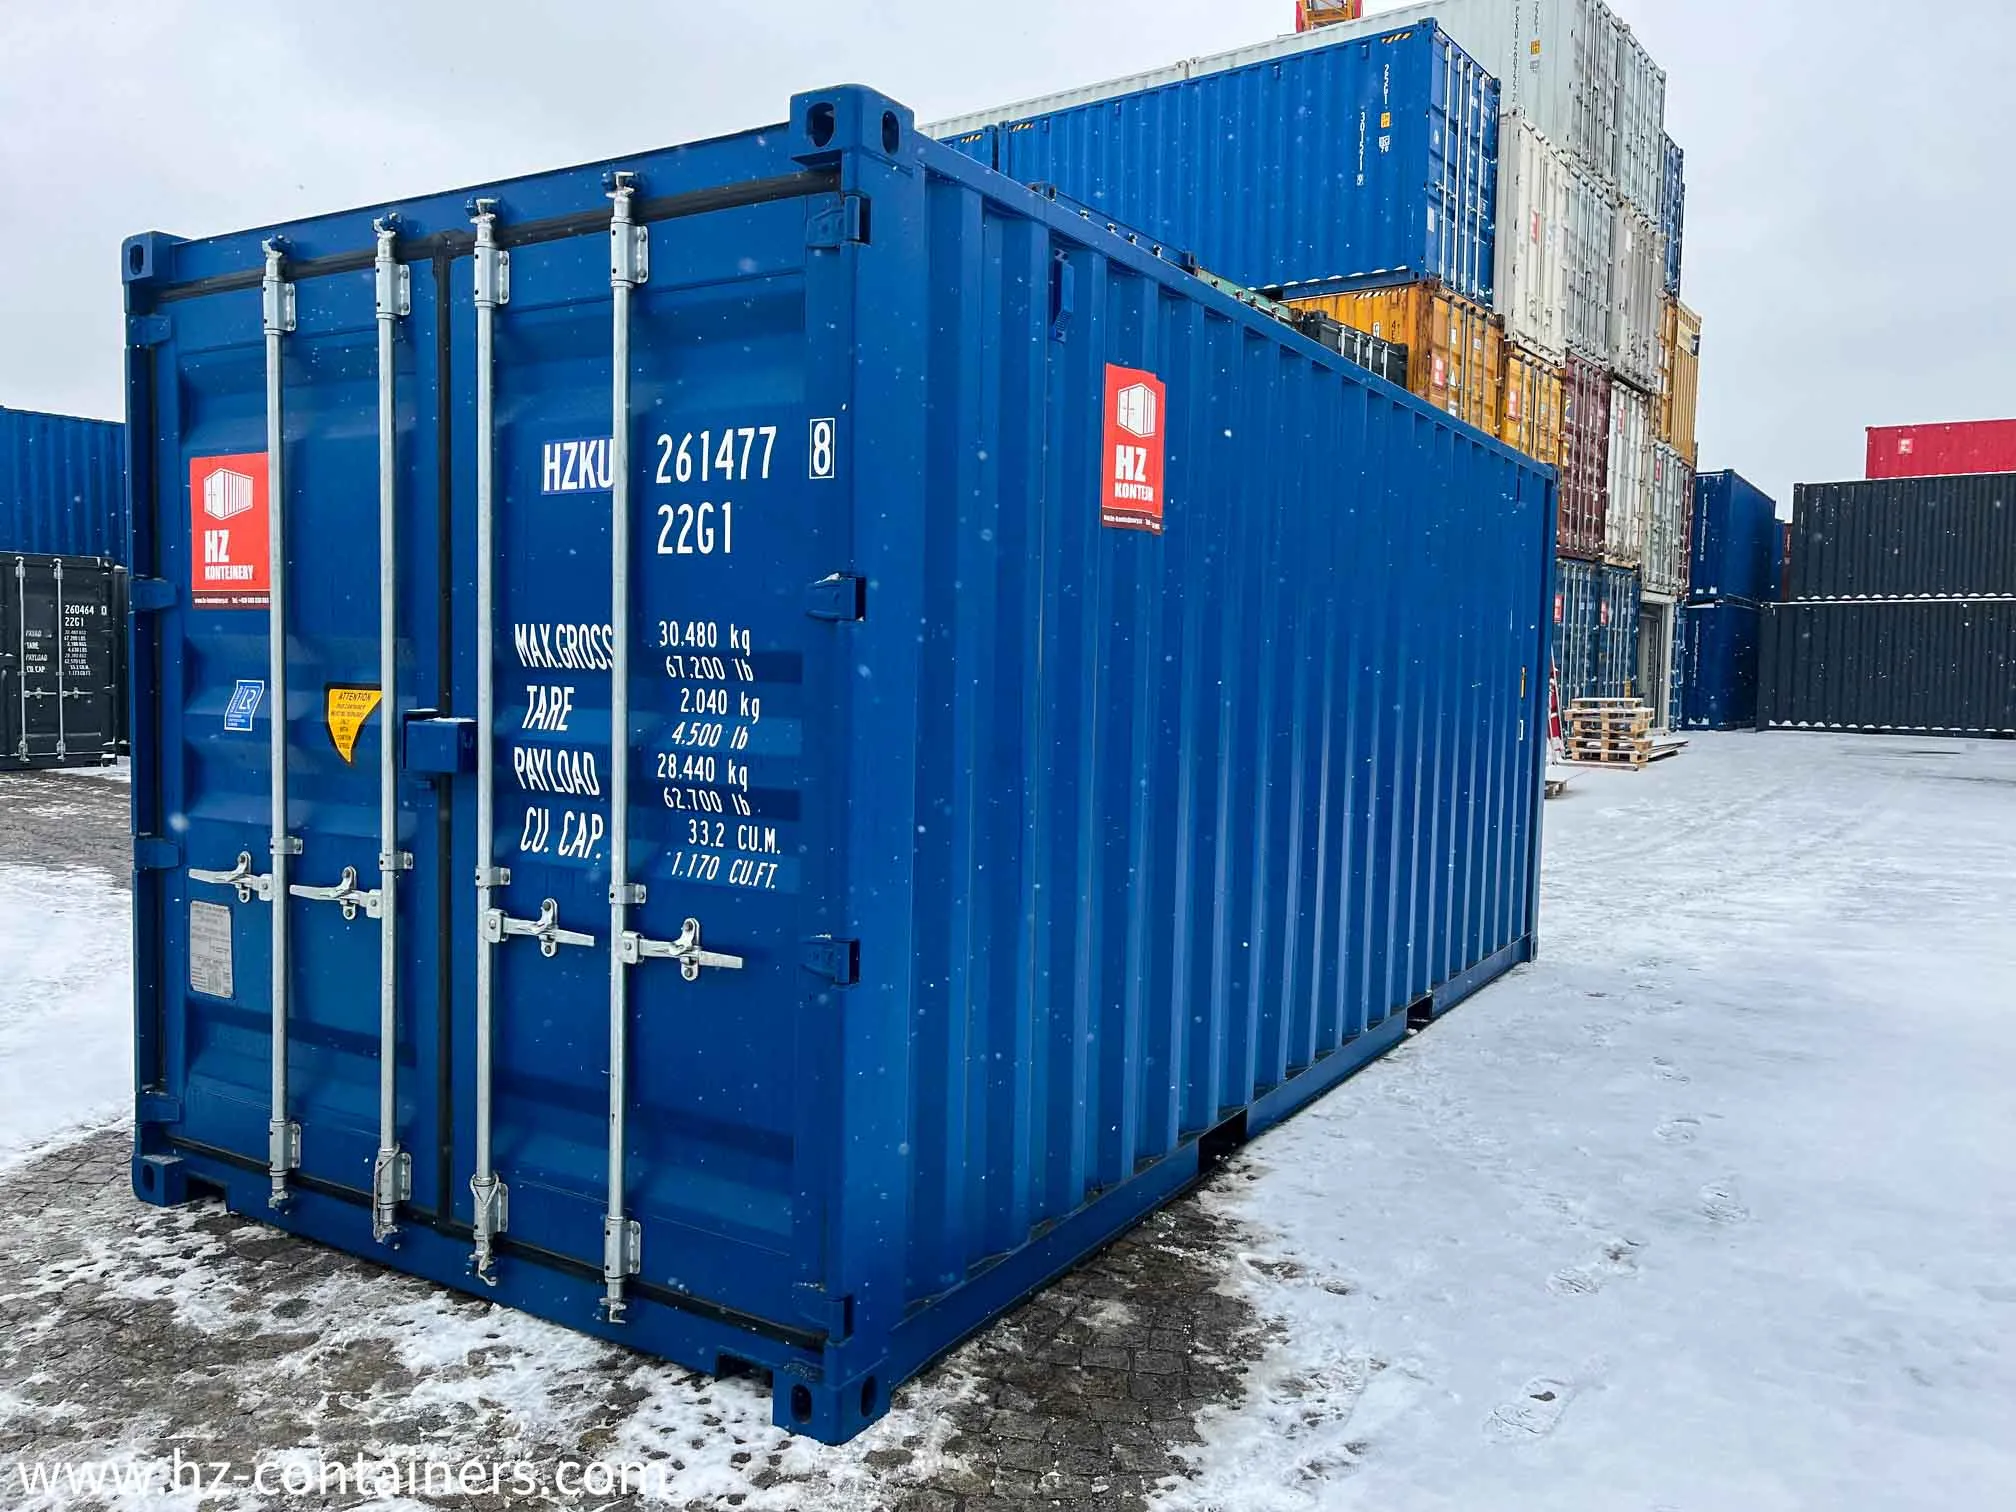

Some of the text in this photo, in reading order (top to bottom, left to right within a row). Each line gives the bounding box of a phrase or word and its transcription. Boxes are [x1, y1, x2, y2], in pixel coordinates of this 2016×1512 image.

[543, 420, 833, 491] HZKU 261477 8
[1115, 445, 1147, 482] HZ
[657, 501, 732, 555] 22G1
[204, 529, 230, 563] HZ
[64, 604, 95, 616] 260464
[64, 616, 84, 627] 22G1
[514, 623, 613, 670] MAX.GROSS
[730, 623, 751, 657] kg
[732, 658, 754, 682] lb
[521, 685, 575, 731] TARE
[740, 691, 760, 724] kg
[729, 725, 749, 750] lb
[513, 746, 600, 796] PAYLOAD
[728, 759, 748, 793] kg
[731, 792, 751, 816] lb
[520, 806, 781, 860] CU. CAP. 33.2 CU.M.
[728, 858, 778, 889] CU.FT.
